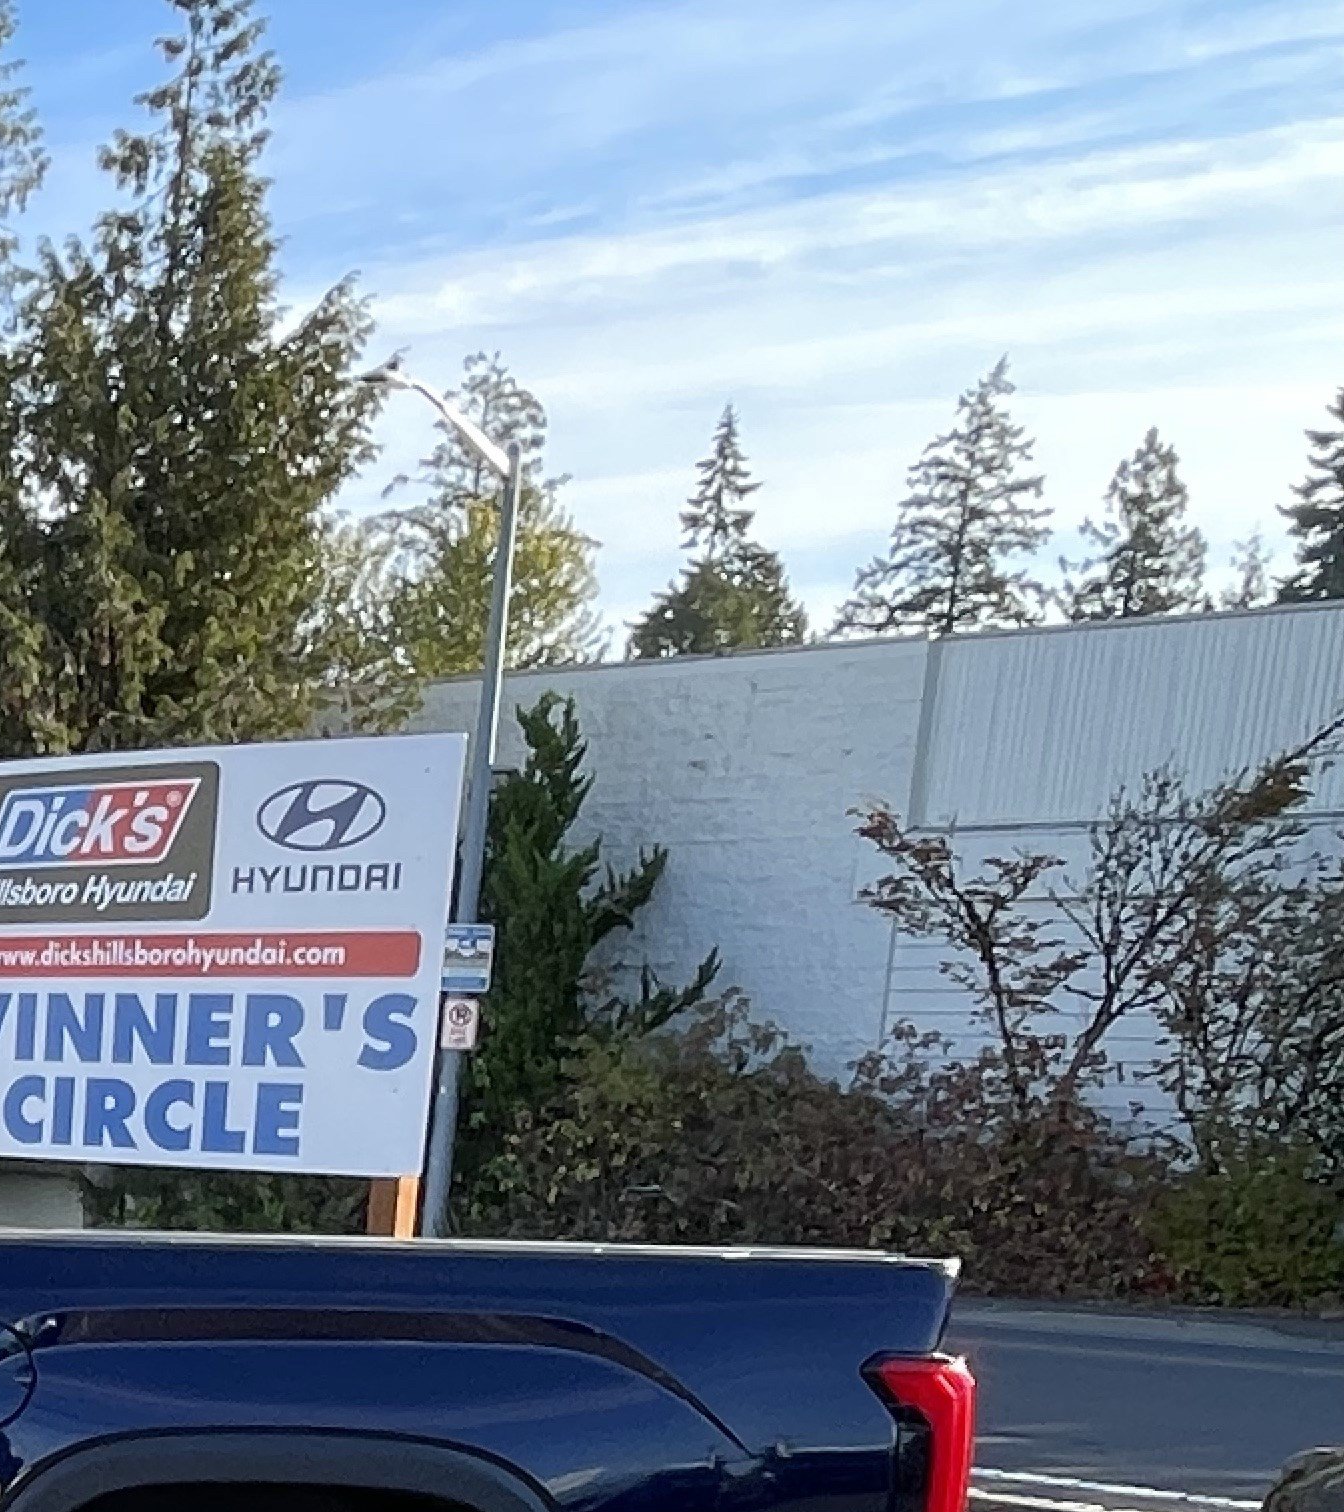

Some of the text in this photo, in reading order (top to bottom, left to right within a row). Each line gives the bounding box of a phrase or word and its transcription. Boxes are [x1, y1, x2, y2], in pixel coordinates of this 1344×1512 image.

[81, 873, 197, 911] Hyundai
[233, 863, 401, 894] HYUNDAI
[3, 1075, 304, 1156] CIRCLE
